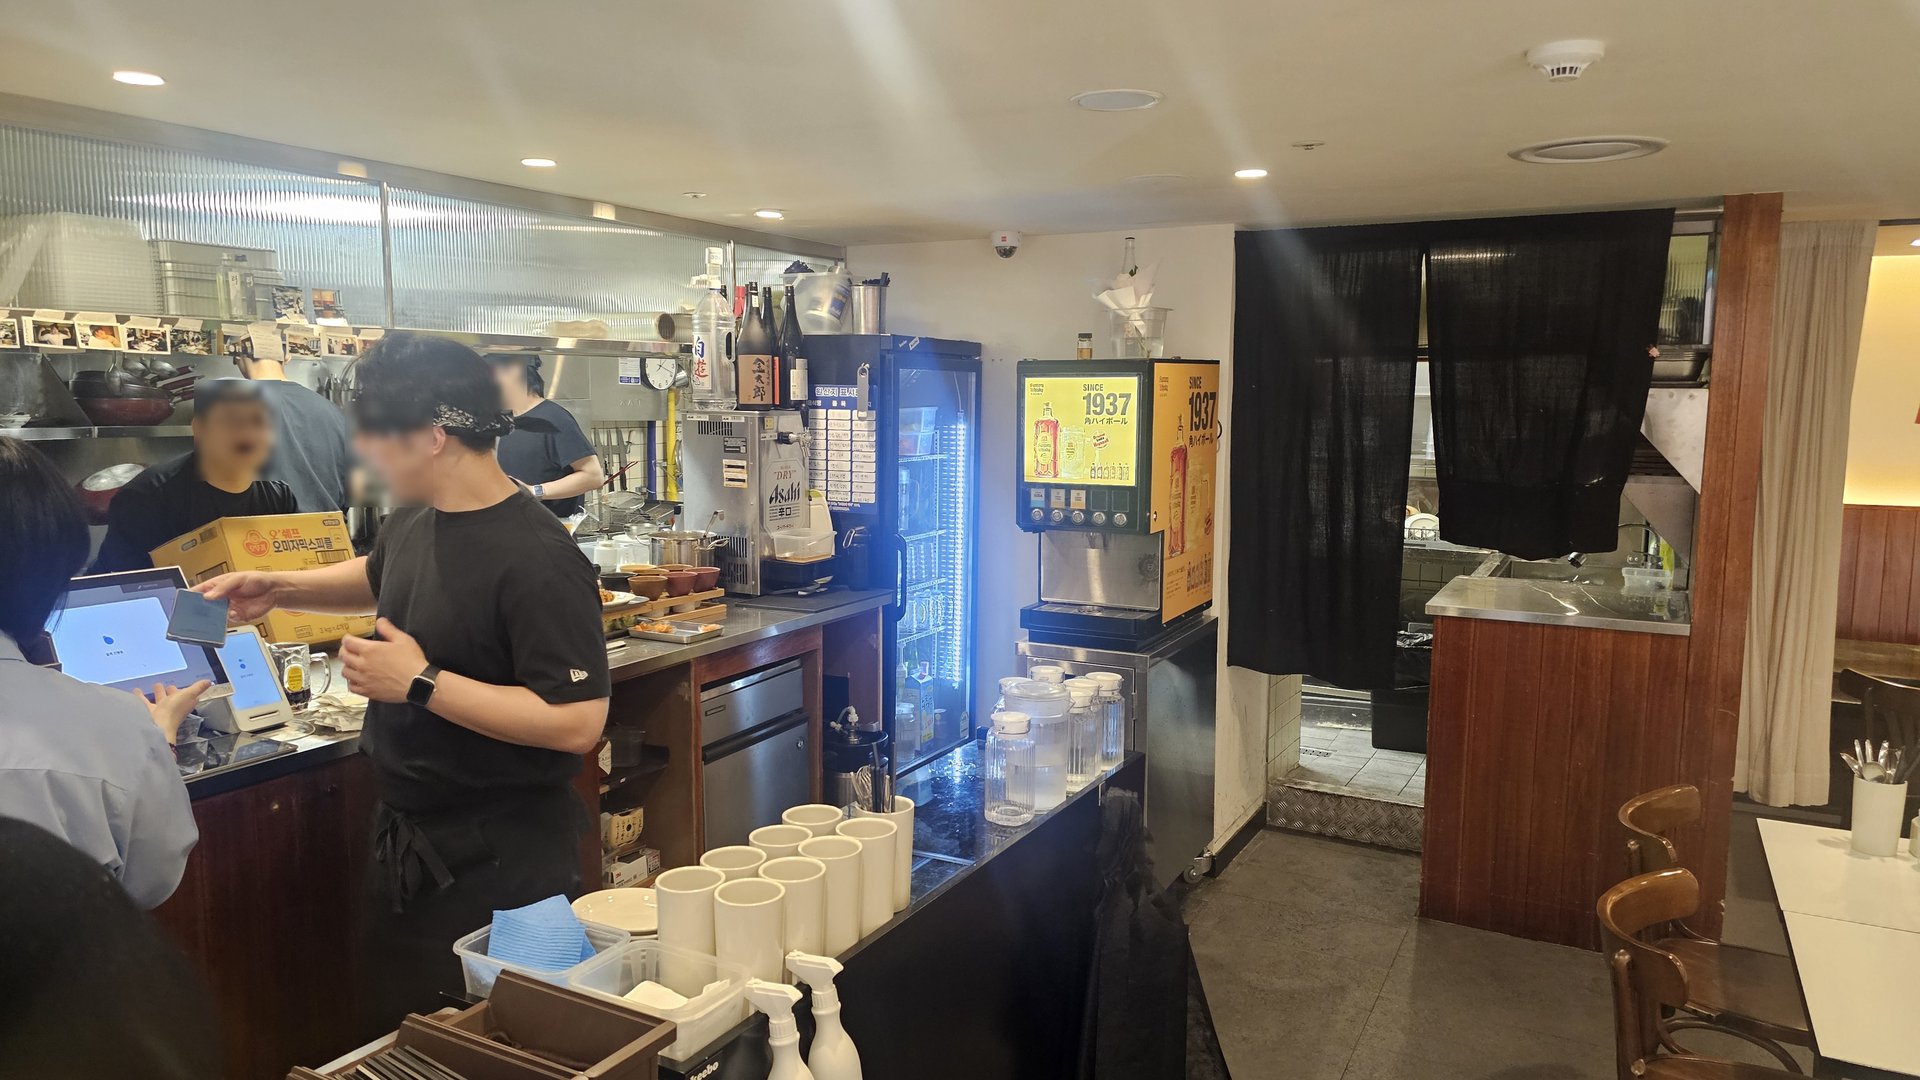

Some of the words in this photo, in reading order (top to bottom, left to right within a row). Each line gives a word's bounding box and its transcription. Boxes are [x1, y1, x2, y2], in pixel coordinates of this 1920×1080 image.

[1082, 383, 1104, 392] SINCE
[1189, 376, 1202, 389] SINCE
[815, 387, 838, 397] 원산지
[840, 387, 859, 397] 표시
[1082, 393, 1132, 415] 1937
[1189, 391, 1217, 431] 1937
[1084, 417, 1128, 425] 角ハイボール
[769, 481, 801, 505] Asahi
[778, 507, 792, 517] 辛口
